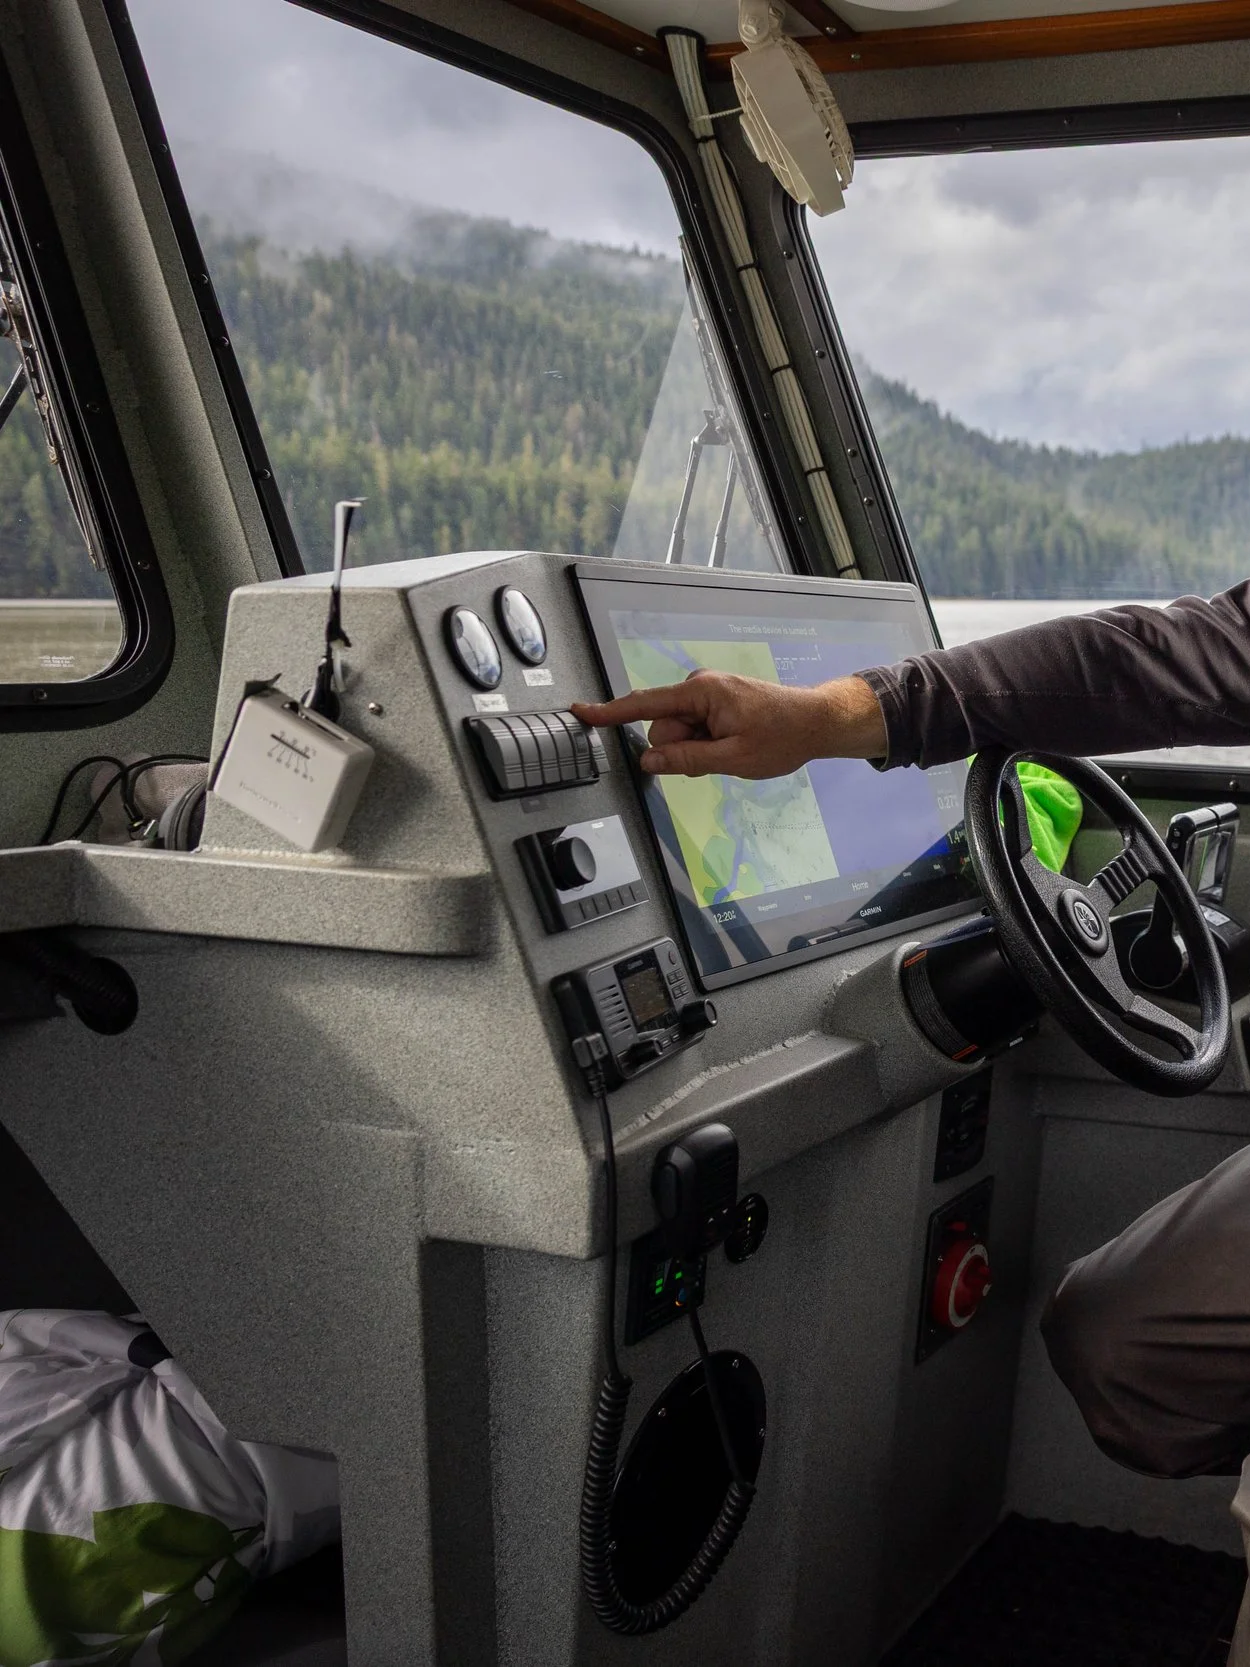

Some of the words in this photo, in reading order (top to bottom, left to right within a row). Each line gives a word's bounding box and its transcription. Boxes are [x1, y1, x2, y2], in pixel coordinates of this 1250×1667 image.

[728, 624, 742, 633] The
[852, 882, 869, 891] Home
[859, 905, 882, 917] GARMIN
[713, 910, 733, 923] 12:20
